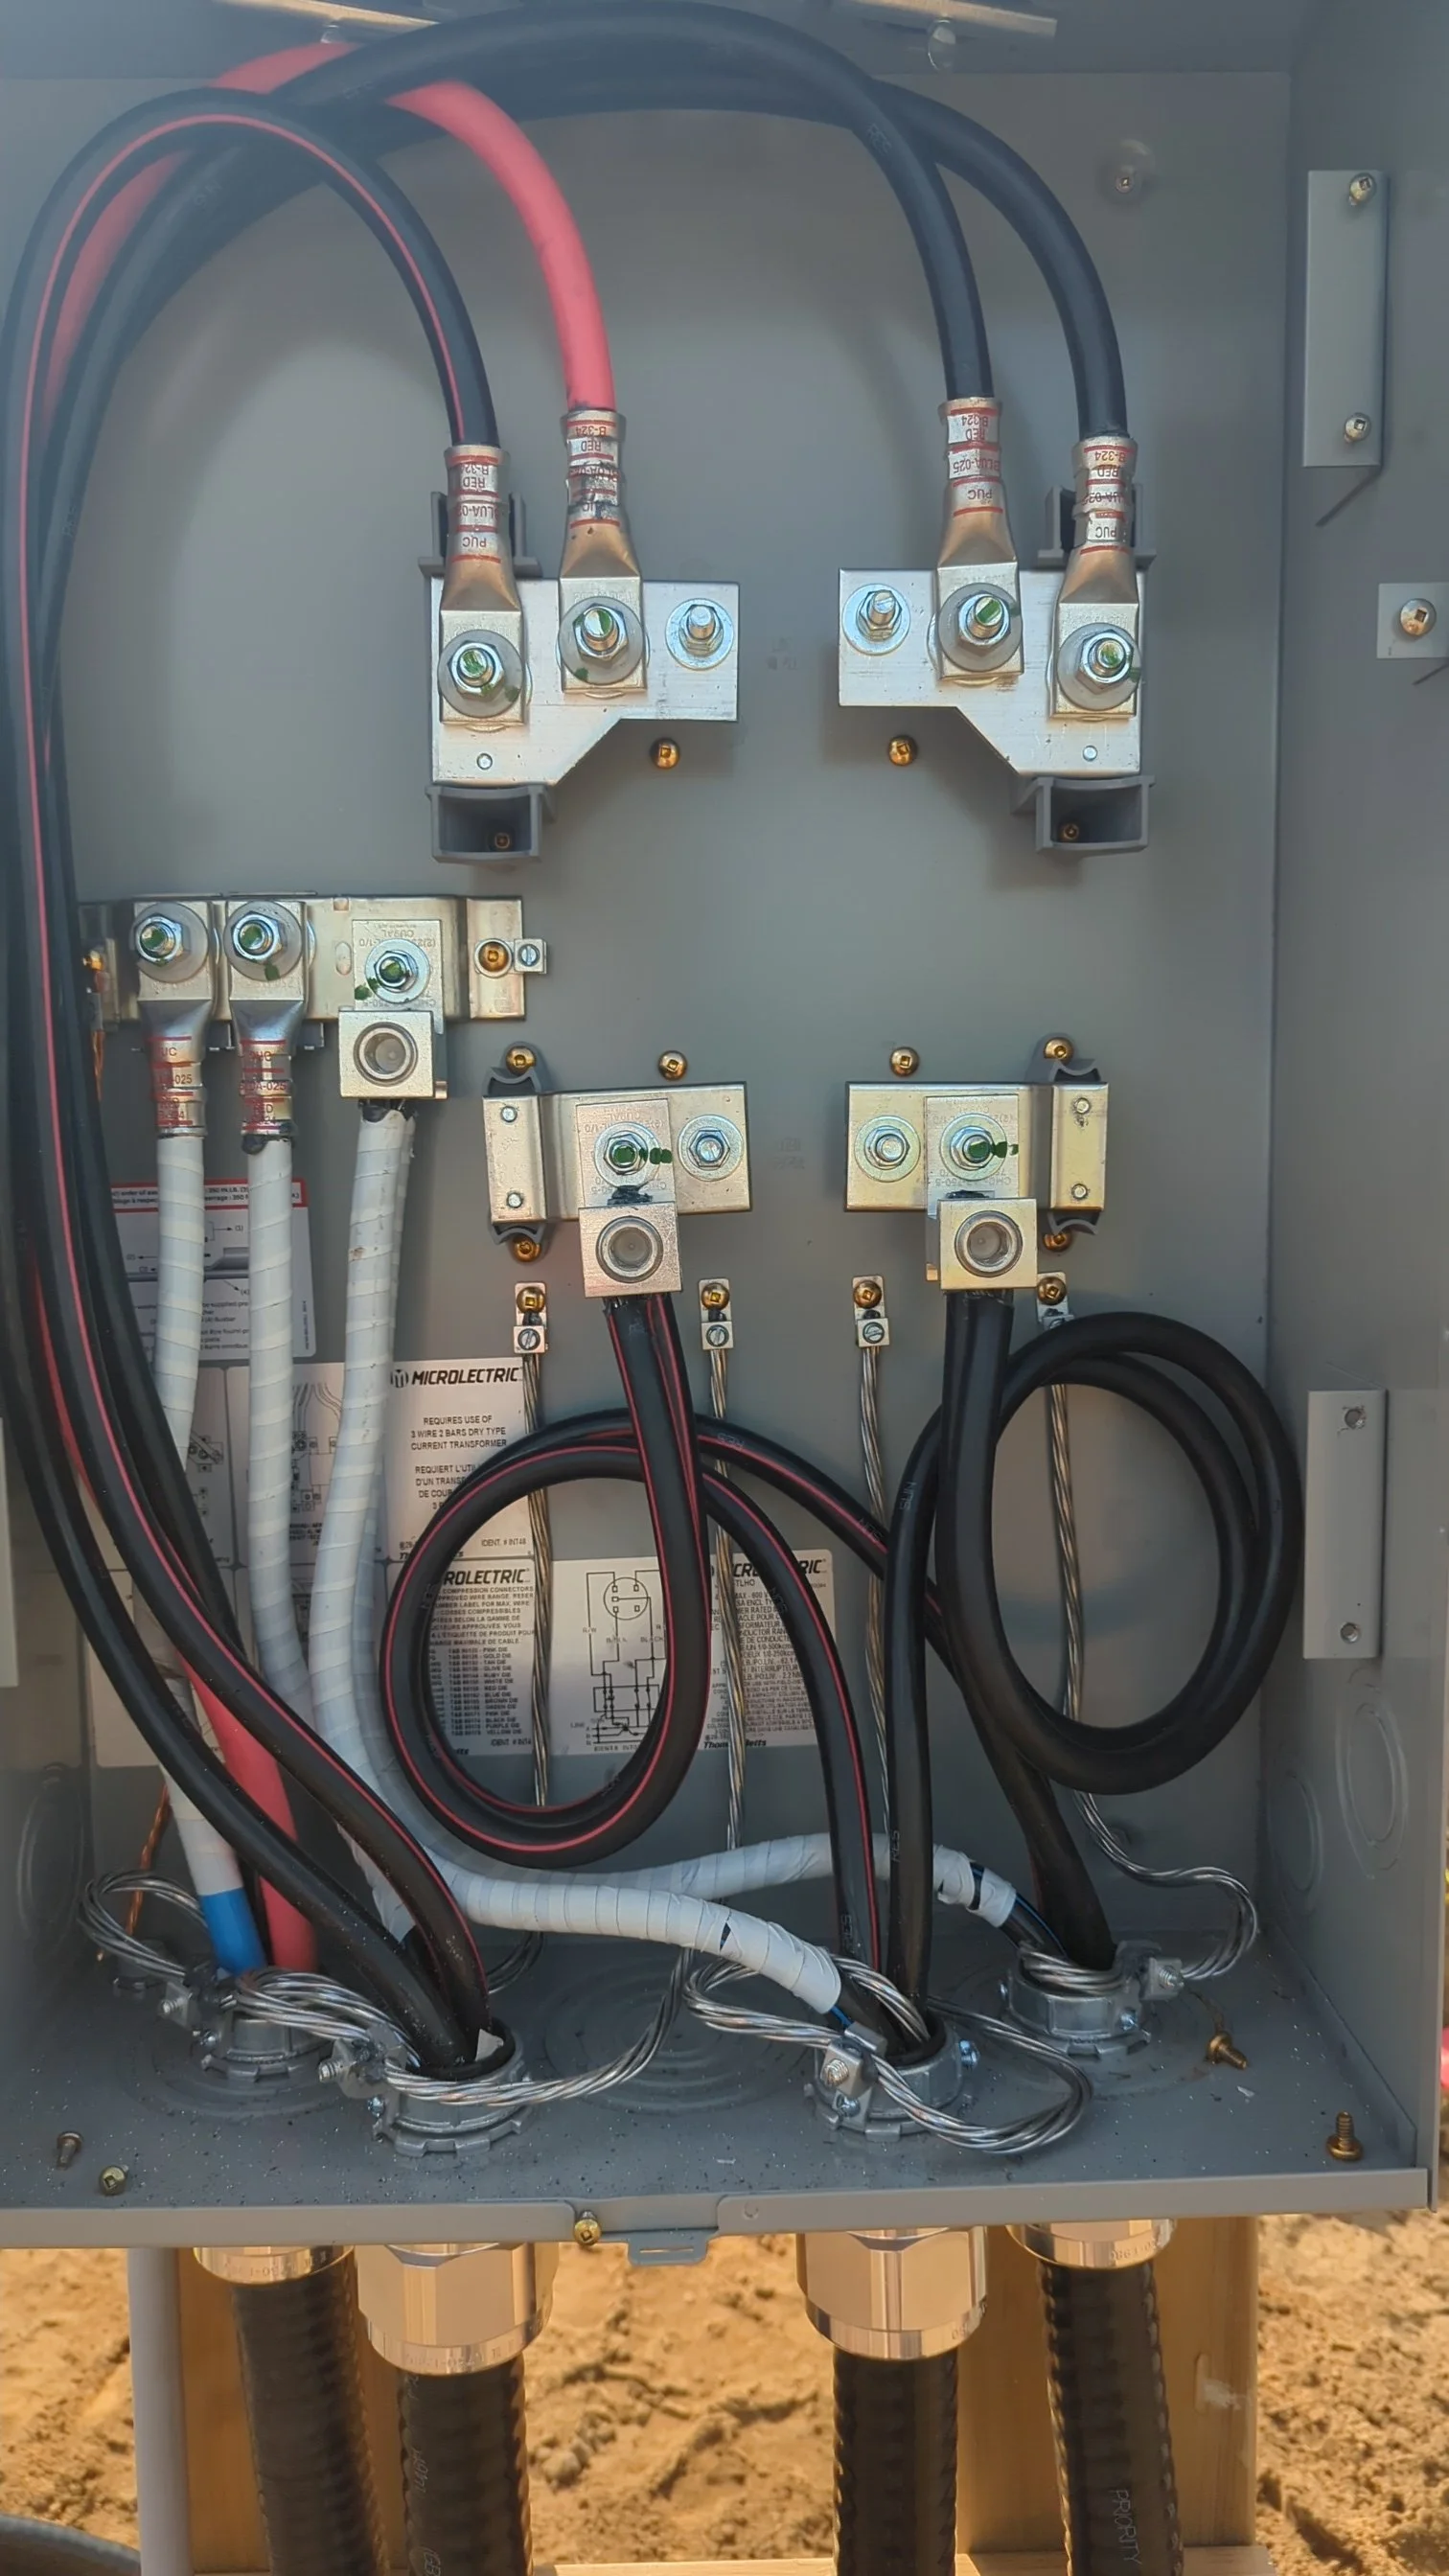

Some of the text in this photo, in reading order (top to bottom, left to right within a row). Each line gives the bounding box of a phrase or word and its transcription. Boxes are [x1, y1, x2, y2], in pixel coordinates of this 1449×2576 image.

[961, 415, 988, 427] B-324
[575, 426, 607, 437] B-324
[965, 427, 986, 441] RED
[581, 440, 602, 452] RED
[1094, 450, 1126, 463] B-324
[463, 476, 486, 489] RED
[968, 489, 993, 500] PUC
[1095, 526, 1117, 539] PUC
[462, 537, 487, 547] PUC
[411, 1368, 519, 1385] MICROLECTRIC
[423, 1414, 493, 1426] REQUIRES USE OF
[410, 1427, 506, 1438] 3 WIRE 2 BARS DRY TYPE
[411, 1438, 507, 1451] CURRENT TRANSFORMER
[415, 1464, 453, 1474] REQUIERT
[419, 1489, 429, 1498] DE
[443, 1569, 525, 1586] ROLECTRIC
[1107, 2488, 1142, 2565] PRIORITY
